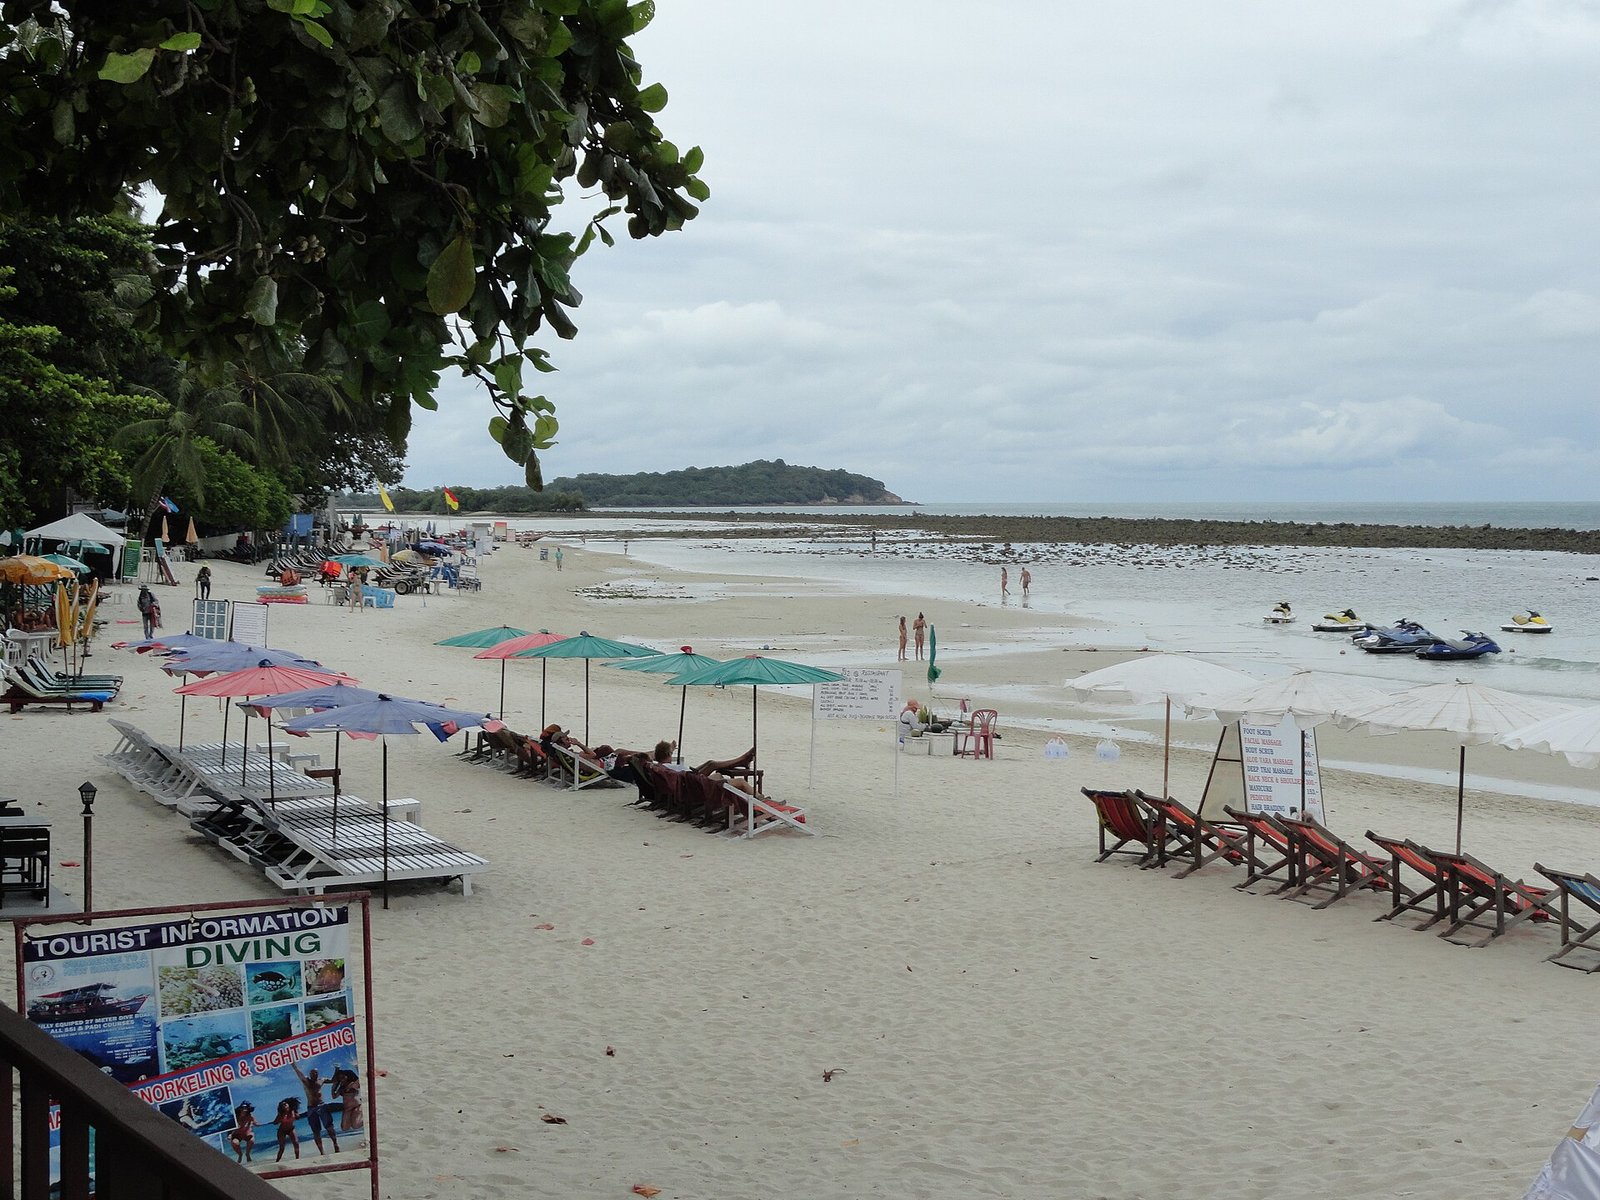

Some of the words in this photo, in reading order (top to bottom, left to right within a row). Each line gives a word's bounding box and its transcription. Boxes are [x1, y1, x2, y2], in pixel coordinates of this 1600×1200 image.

[1261, 738, 1282, 746] MASSAGE
[1272, 758, 1294, 766] MASSAGE
[1249, 784, 1273, 792] MANICURE
[1250, 794, 1273, 802] PEDICURE
[1251, 803, 1263, 811] HAIR
[1263, 804, 1286, 812] BRAIDING
[32, 928, 152, 958] TOURIST
[161, 908, 339, 944] INFORMATION
[186, 932, 322, 969] DIVING
[55, 1020, 84, 1028] EQUIPED
[94, 1016, 118, 1024] METER
[84, 1023, 102, 1031] PADI
[103, 1019, 135, 1028] COURSES
[239, 1061, 251, 1077] &
[254, 1027, 356, 1073] SIGHTSEEING
